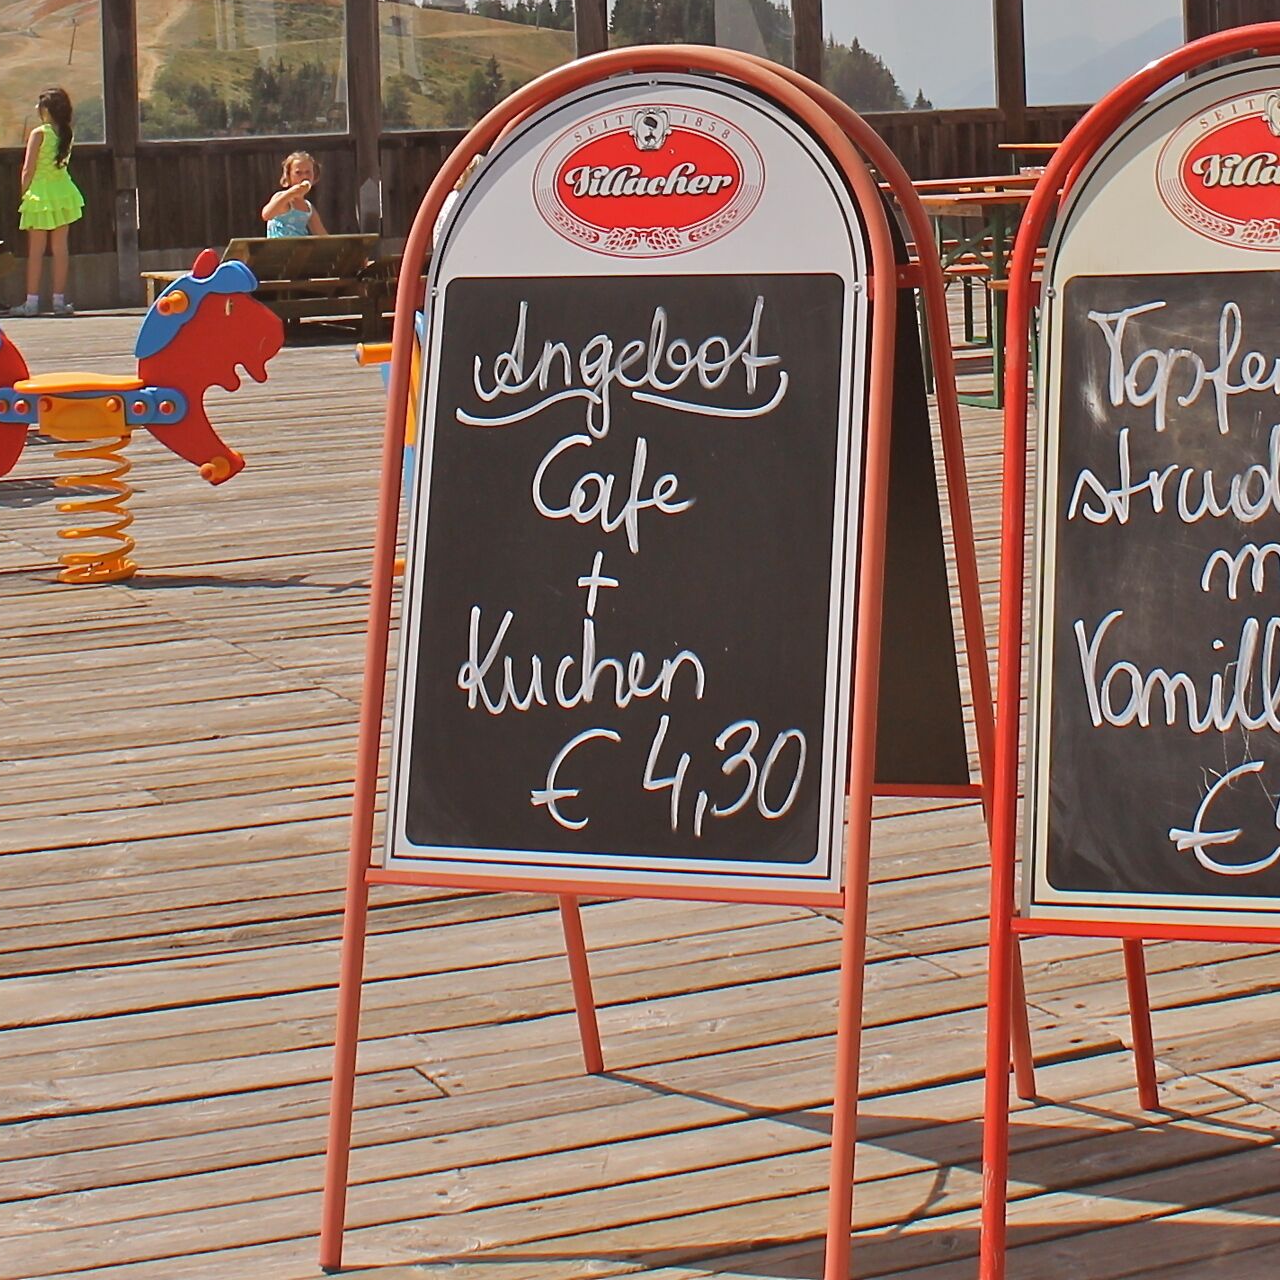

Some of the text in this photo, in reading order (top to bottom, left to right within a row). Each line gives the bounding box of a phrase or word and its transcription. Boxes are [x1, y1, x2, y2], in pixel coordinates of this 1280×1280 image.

[575, 113, 731, 142] SEIT 1858
[1200, 97, 1255, 129] SEIT
[564, 162, 733, 197] Villacher
[474, 295, 784, 440] Angebot
[532, 433, 695, 555] Cafe
[577, 550, 620, 617] +
[457, 606, 706, 715] Kuchen
[530, 714, 808, 837] € 4,30
